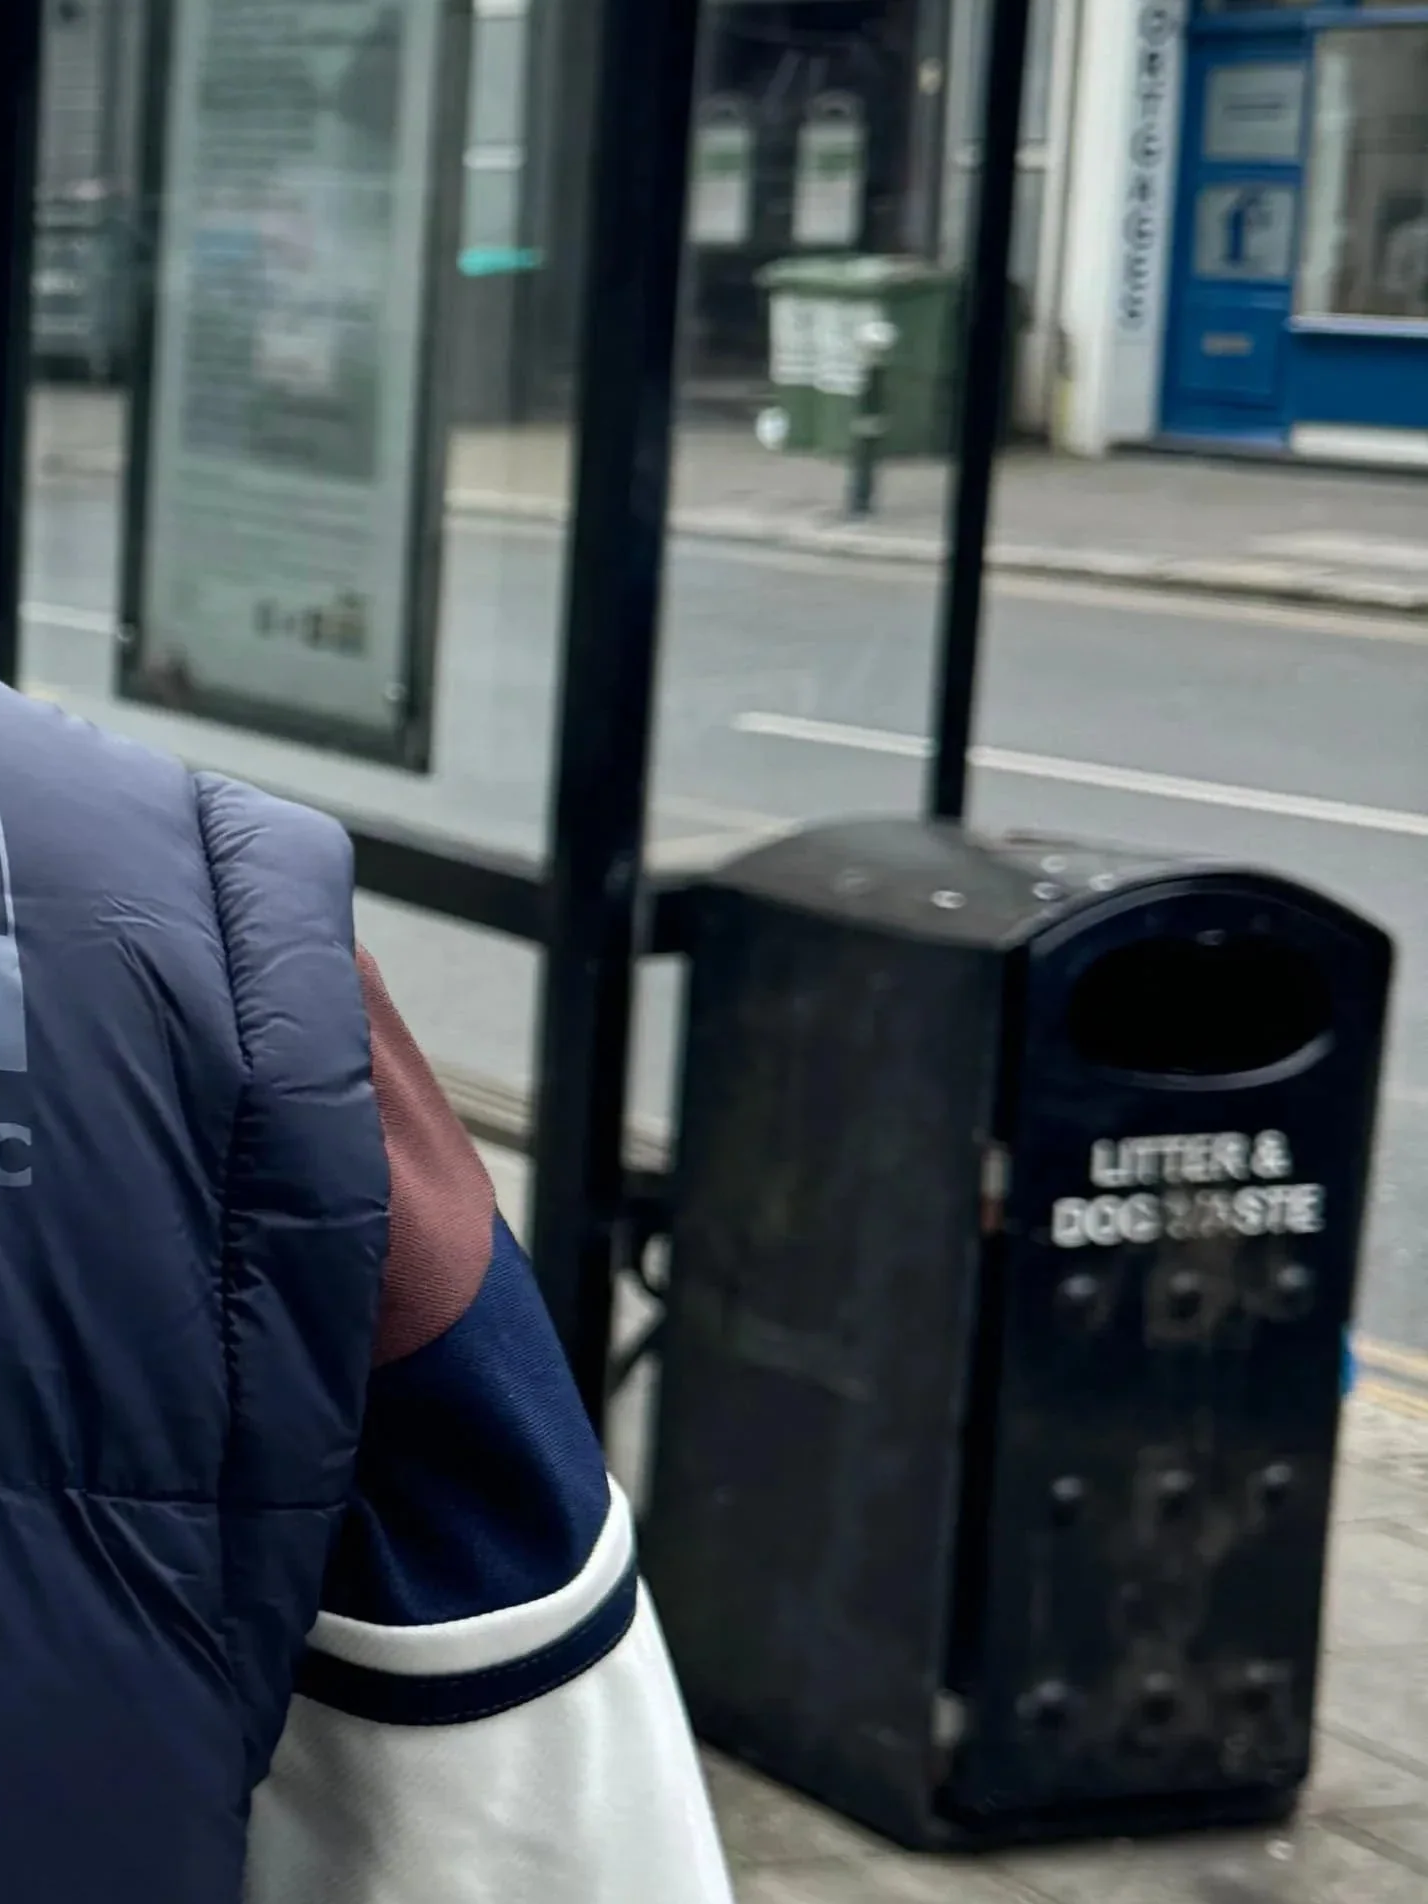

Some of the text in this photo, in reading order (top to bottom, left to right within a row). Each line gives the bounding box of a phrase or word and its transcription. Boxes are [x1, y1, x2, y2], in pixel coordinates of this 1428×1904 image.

[1090, 1129, 1293, 1187] LITTER &
[1051, 1193, 1161, 1248] DOG
